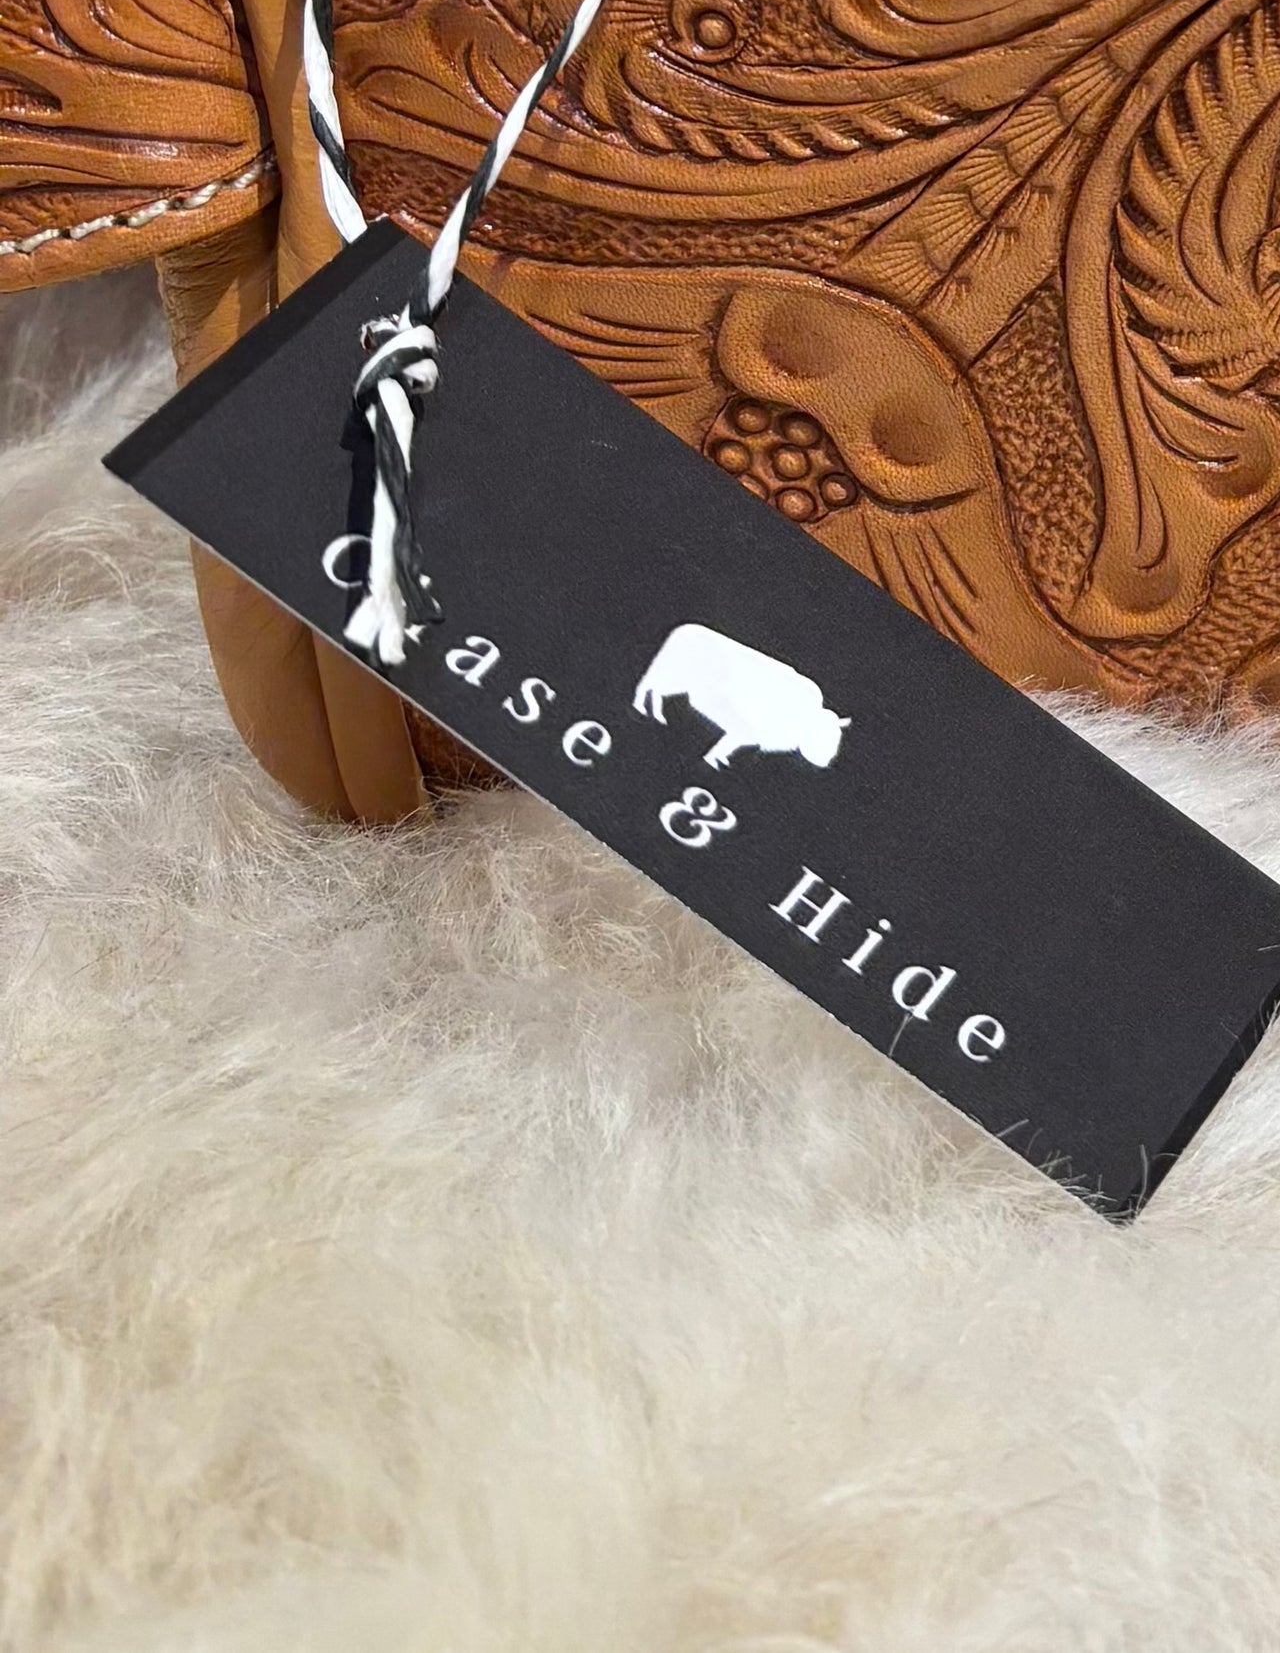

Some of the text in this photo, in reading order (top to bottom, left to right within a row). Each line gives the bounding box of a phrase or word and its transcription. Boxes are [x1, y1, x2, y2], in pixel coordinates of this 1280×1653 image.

[321, 533, 1007, 1064] Case & Hide
